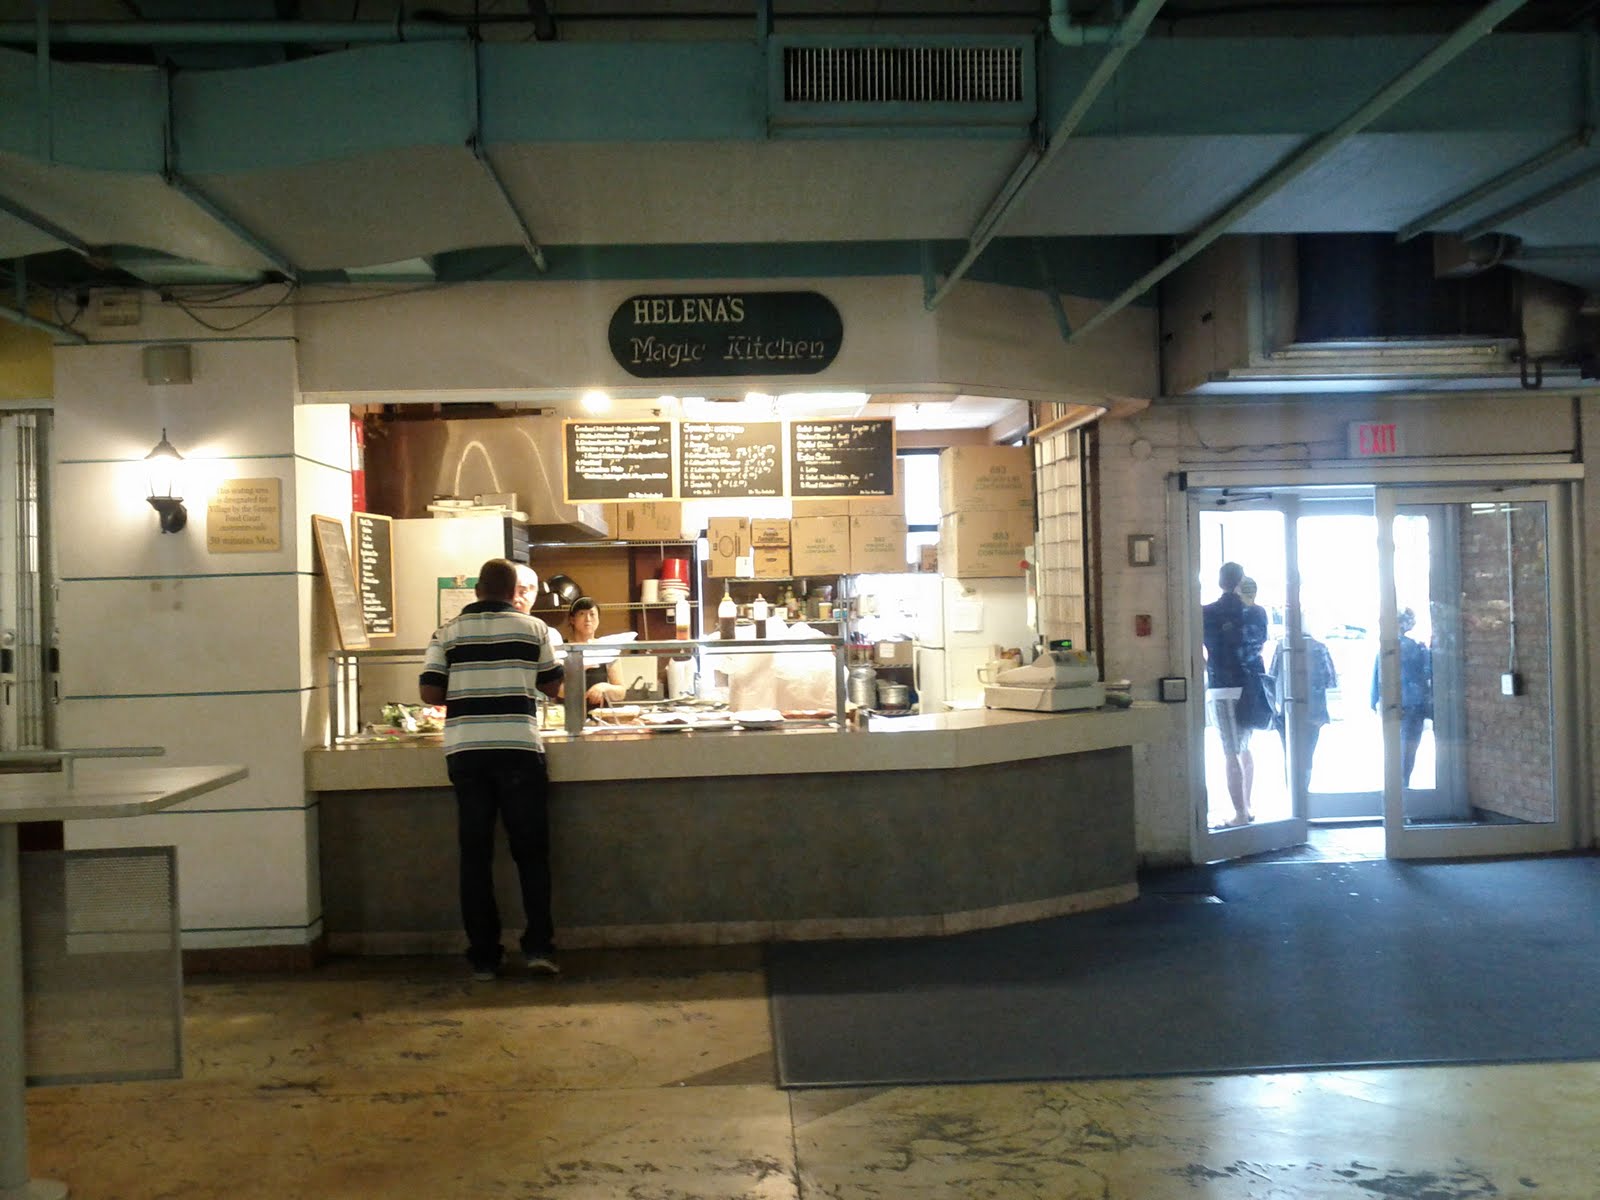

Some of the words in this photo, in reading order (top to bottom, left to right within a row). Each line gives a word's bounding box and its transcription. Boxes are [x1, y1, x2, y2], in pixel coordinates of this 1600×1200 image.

[634, 296, 745, 324] HELENA'S
[630, 336, 706, 368] Magic
[723, 336, 825, 361] Kitchen
[1359, 423, 1397, 455] EXIT
